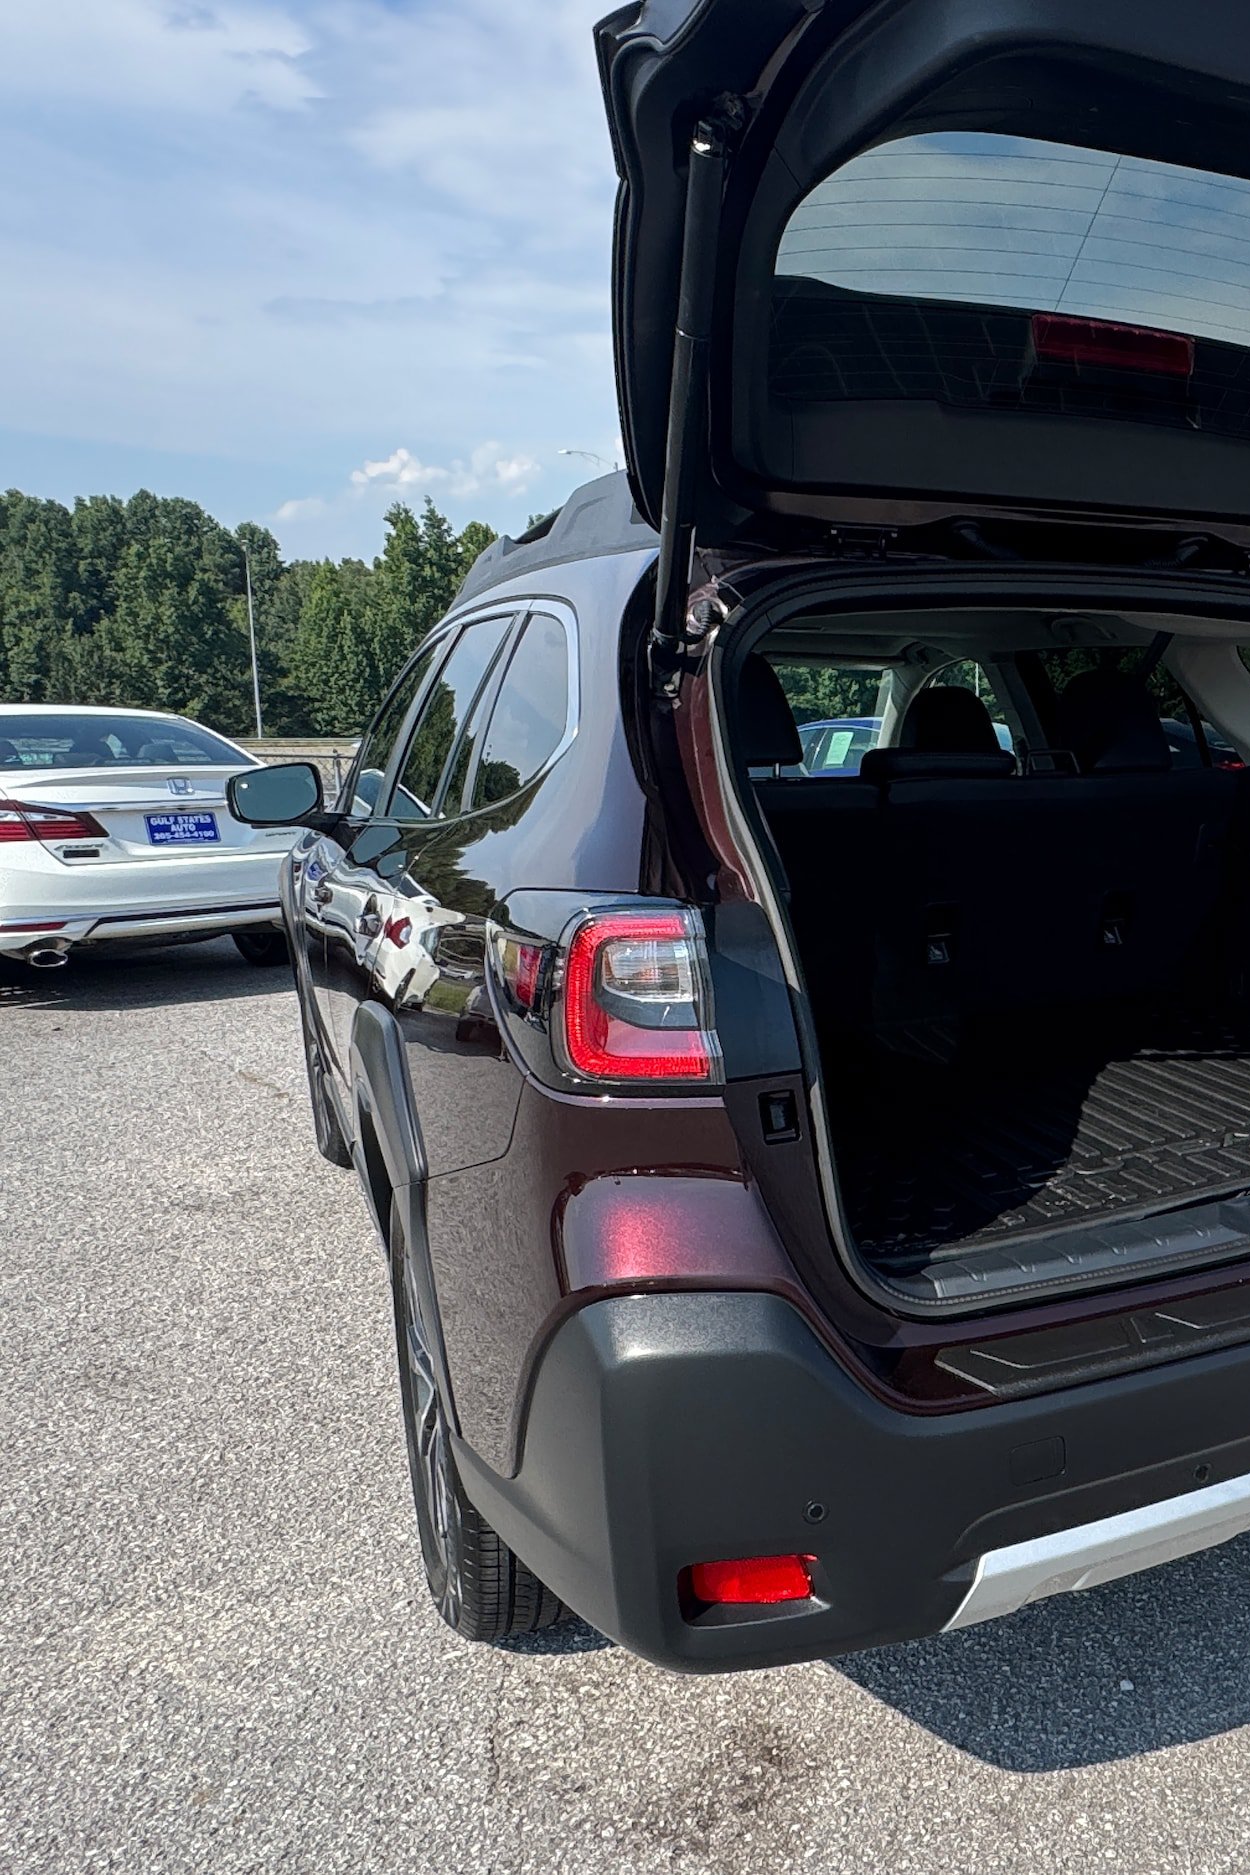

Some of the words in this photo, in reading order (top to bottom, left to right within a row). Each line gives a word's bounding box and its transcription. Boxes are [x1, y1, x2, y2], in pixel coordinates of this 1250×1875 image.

[151, 817, 175, 826] GULF
[178, 815, 212, 824] STATES
[172, 824, 196, 832] AUTO
